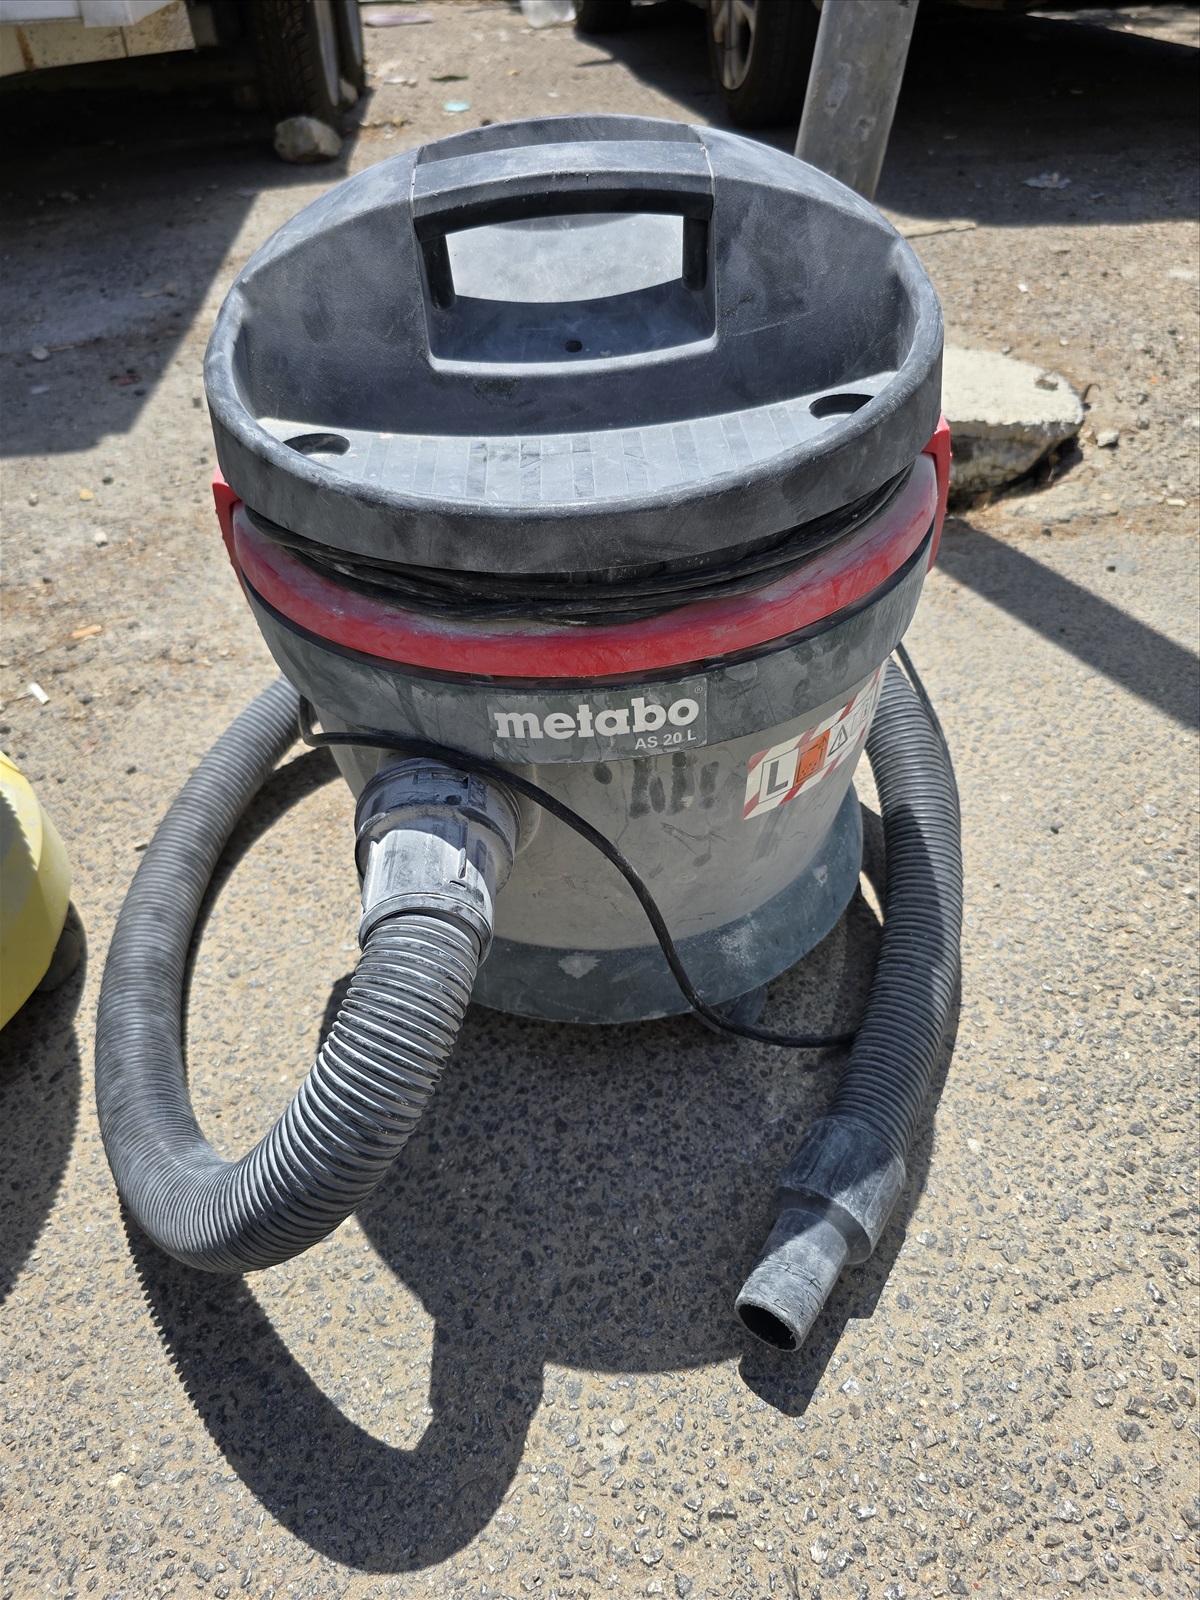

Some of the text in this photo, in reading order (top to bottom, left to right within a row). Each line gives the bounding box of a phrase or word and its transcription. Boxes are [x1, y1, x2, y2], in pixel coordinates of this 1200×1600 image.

[494, 697, 700, 740] metabo
[634, 729, 697, 750] AS 20 L
[766, 760, 789, 796] L
